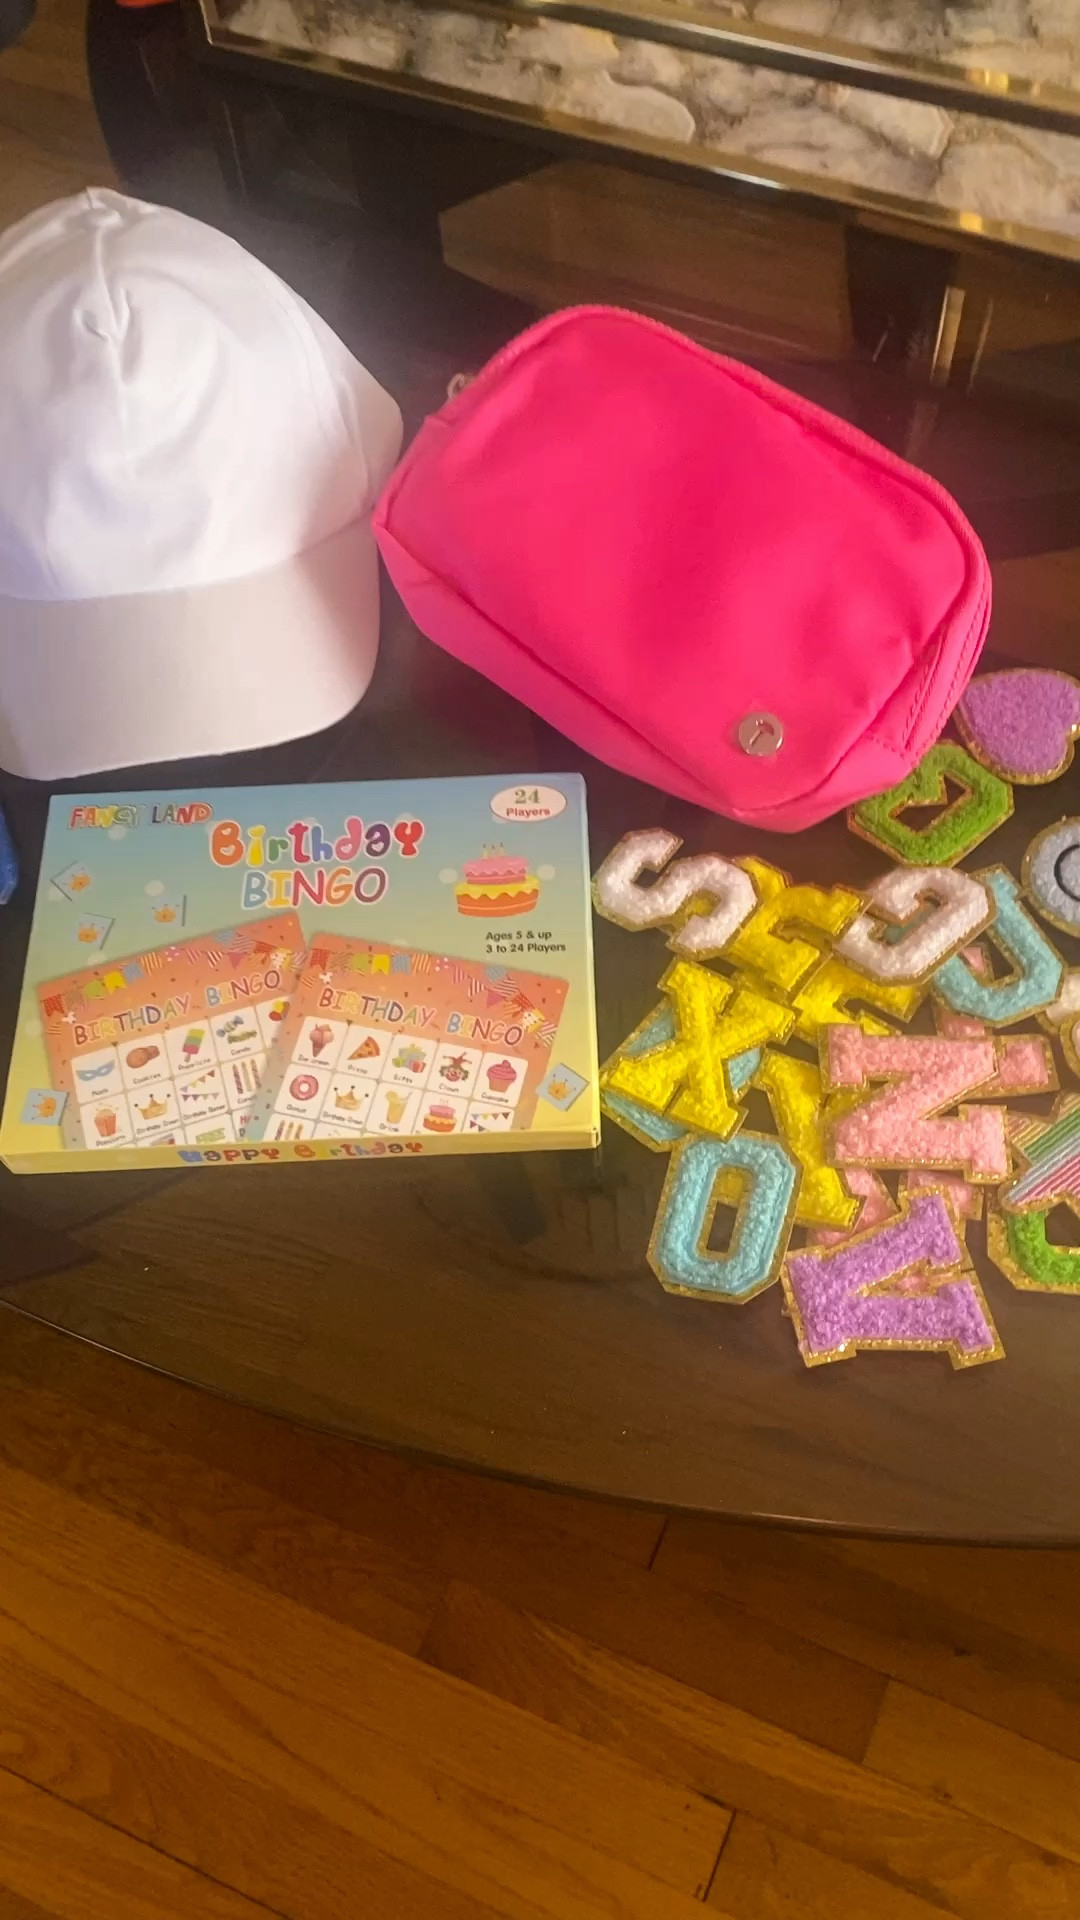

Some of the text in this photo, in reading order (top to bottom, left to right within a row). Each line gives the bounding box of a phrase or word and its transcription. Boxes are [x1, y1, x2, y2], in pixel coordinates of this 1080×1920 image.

[506, 806, 550, 818] Players
[514, 788, 540, 805] 24
[69, 802, 213, 829] FANCY LAND
[241, 866, 388, 909] BINGO
[597, 830, 756, 958] S
[485, 930, 552, 942] Ages 5 & up
[485, 943, 566, 954] 3 to 24 Players
[74, 970, 280, 1046] BIRTHDAY BINGO
[318, 987, 523, 1046] BIRTHDAY BINGO
[606, 958, 797, 1137] X
